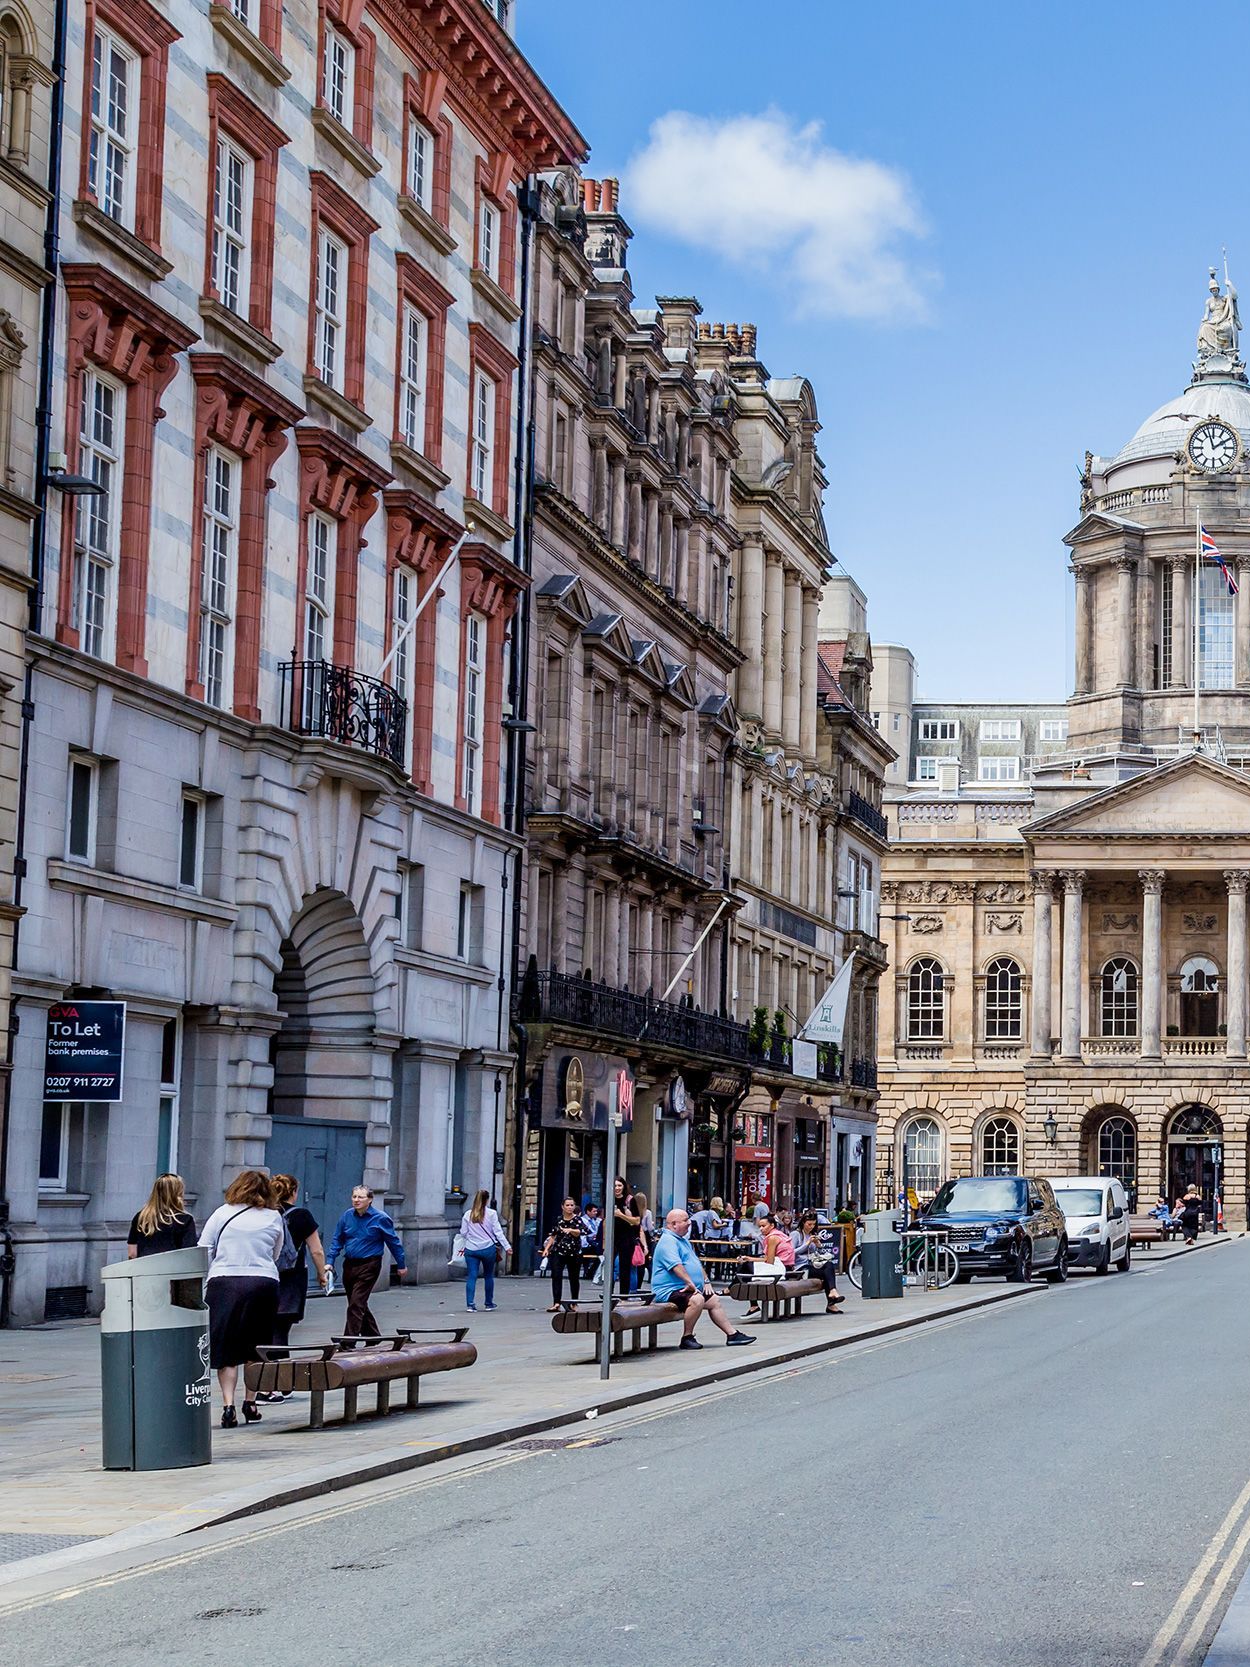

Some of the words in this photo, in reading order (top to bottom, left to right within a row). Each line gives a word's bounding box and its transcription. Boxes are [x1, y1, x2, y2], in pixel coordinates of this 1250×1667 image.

[49, 1007, 80, 1018] GVA
[49, 1021, 72, 1036] To
[74, 1021, 102, 1036] Let
[48, 1039, 79, 1047] Former
[71, 1048, 109, 1057] premises
[46, 1077, 72, 1087] 0207
[73, 1077, 89, 1087] 911
[91, 1077, 115, 1087] 2727
[185, 1396, 201, 1407] City
